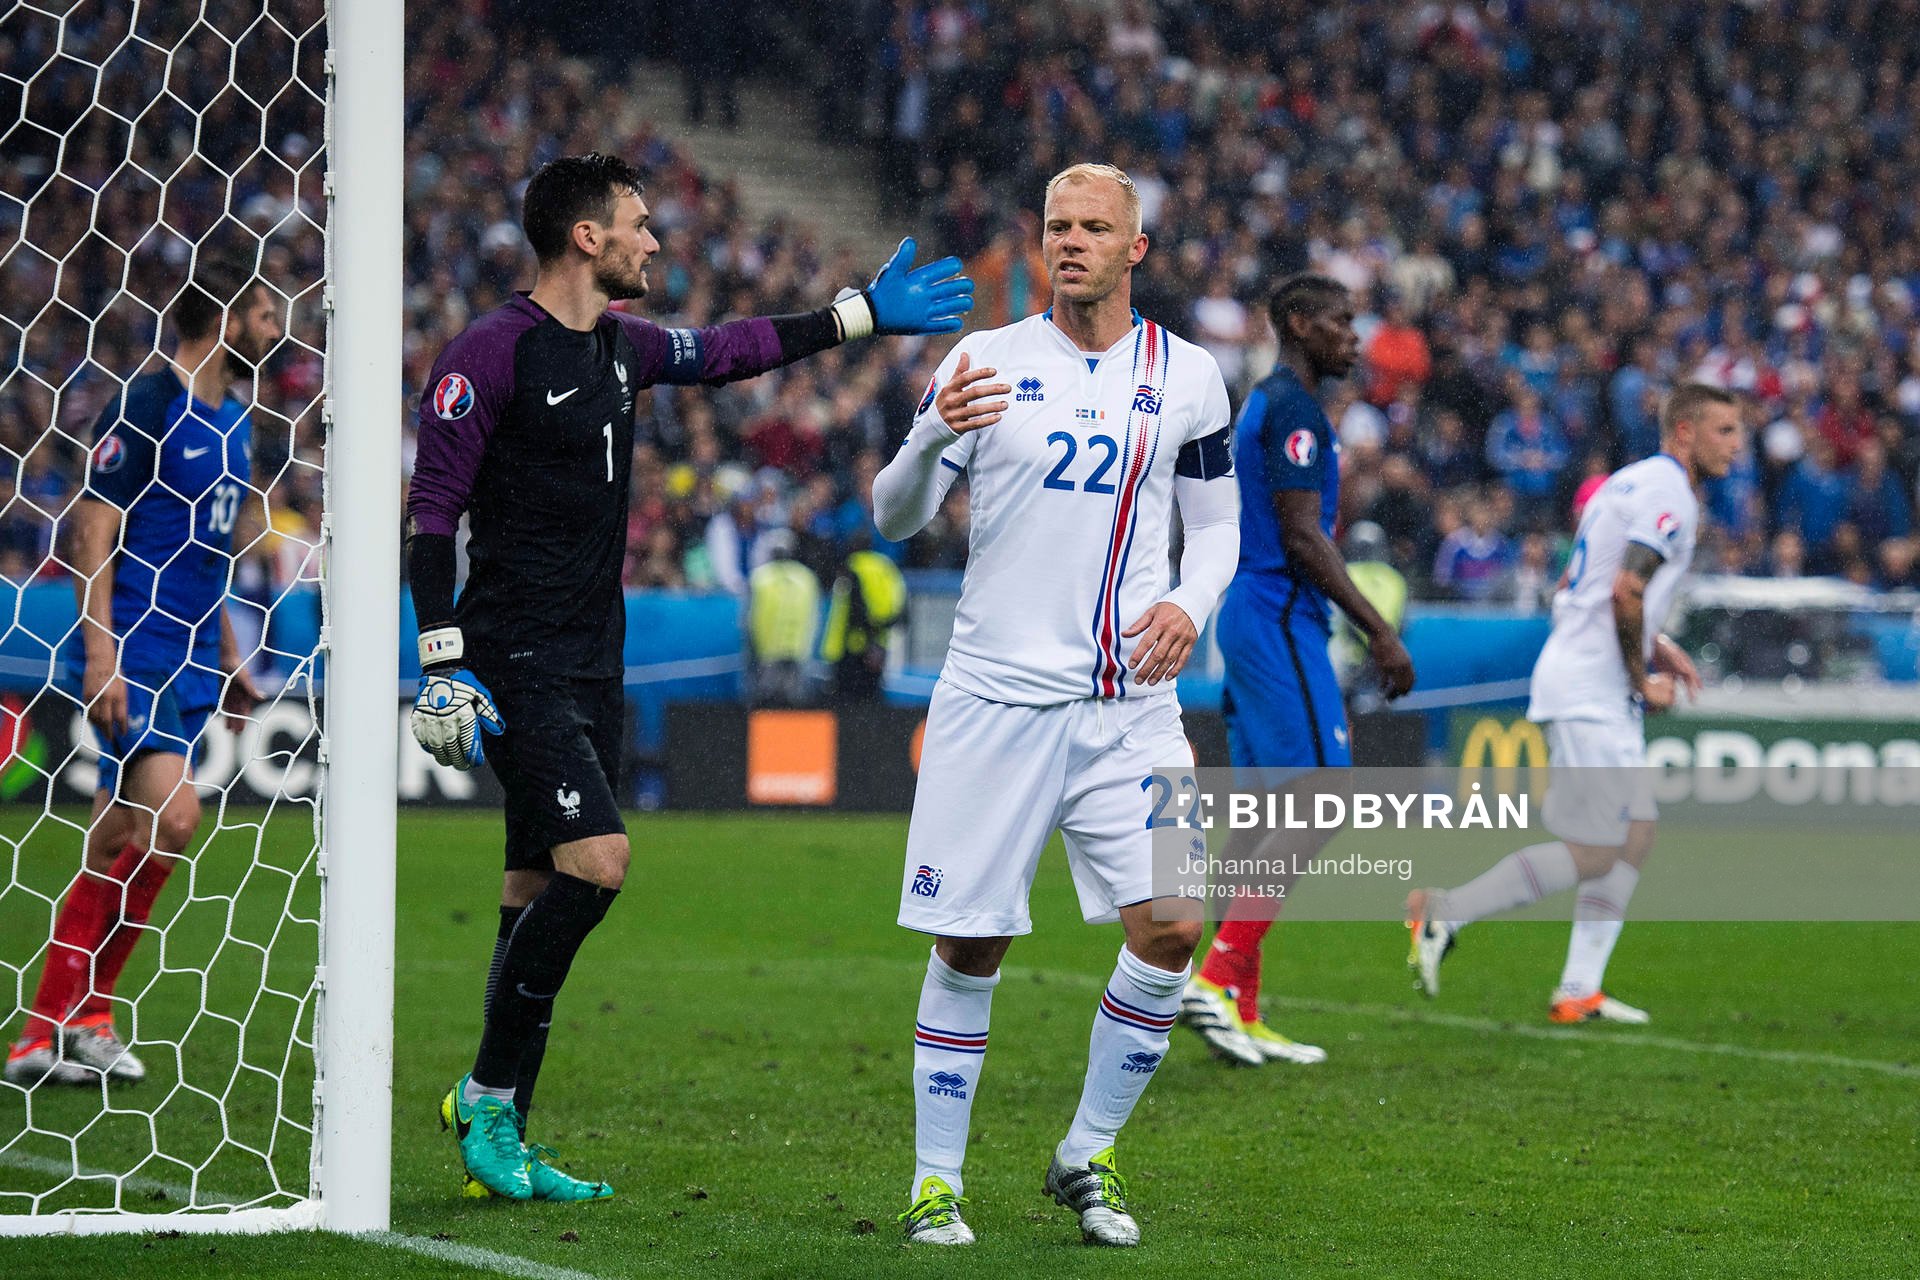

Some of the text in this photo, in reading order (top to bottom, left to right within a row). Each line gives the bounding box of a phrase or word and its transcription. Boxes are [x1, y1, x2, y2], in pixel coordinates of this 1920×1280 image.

[602, 422, 614, 483] 1
[1043, 431, 1119, 495] 22
[207, 483, 241, 535] 10
